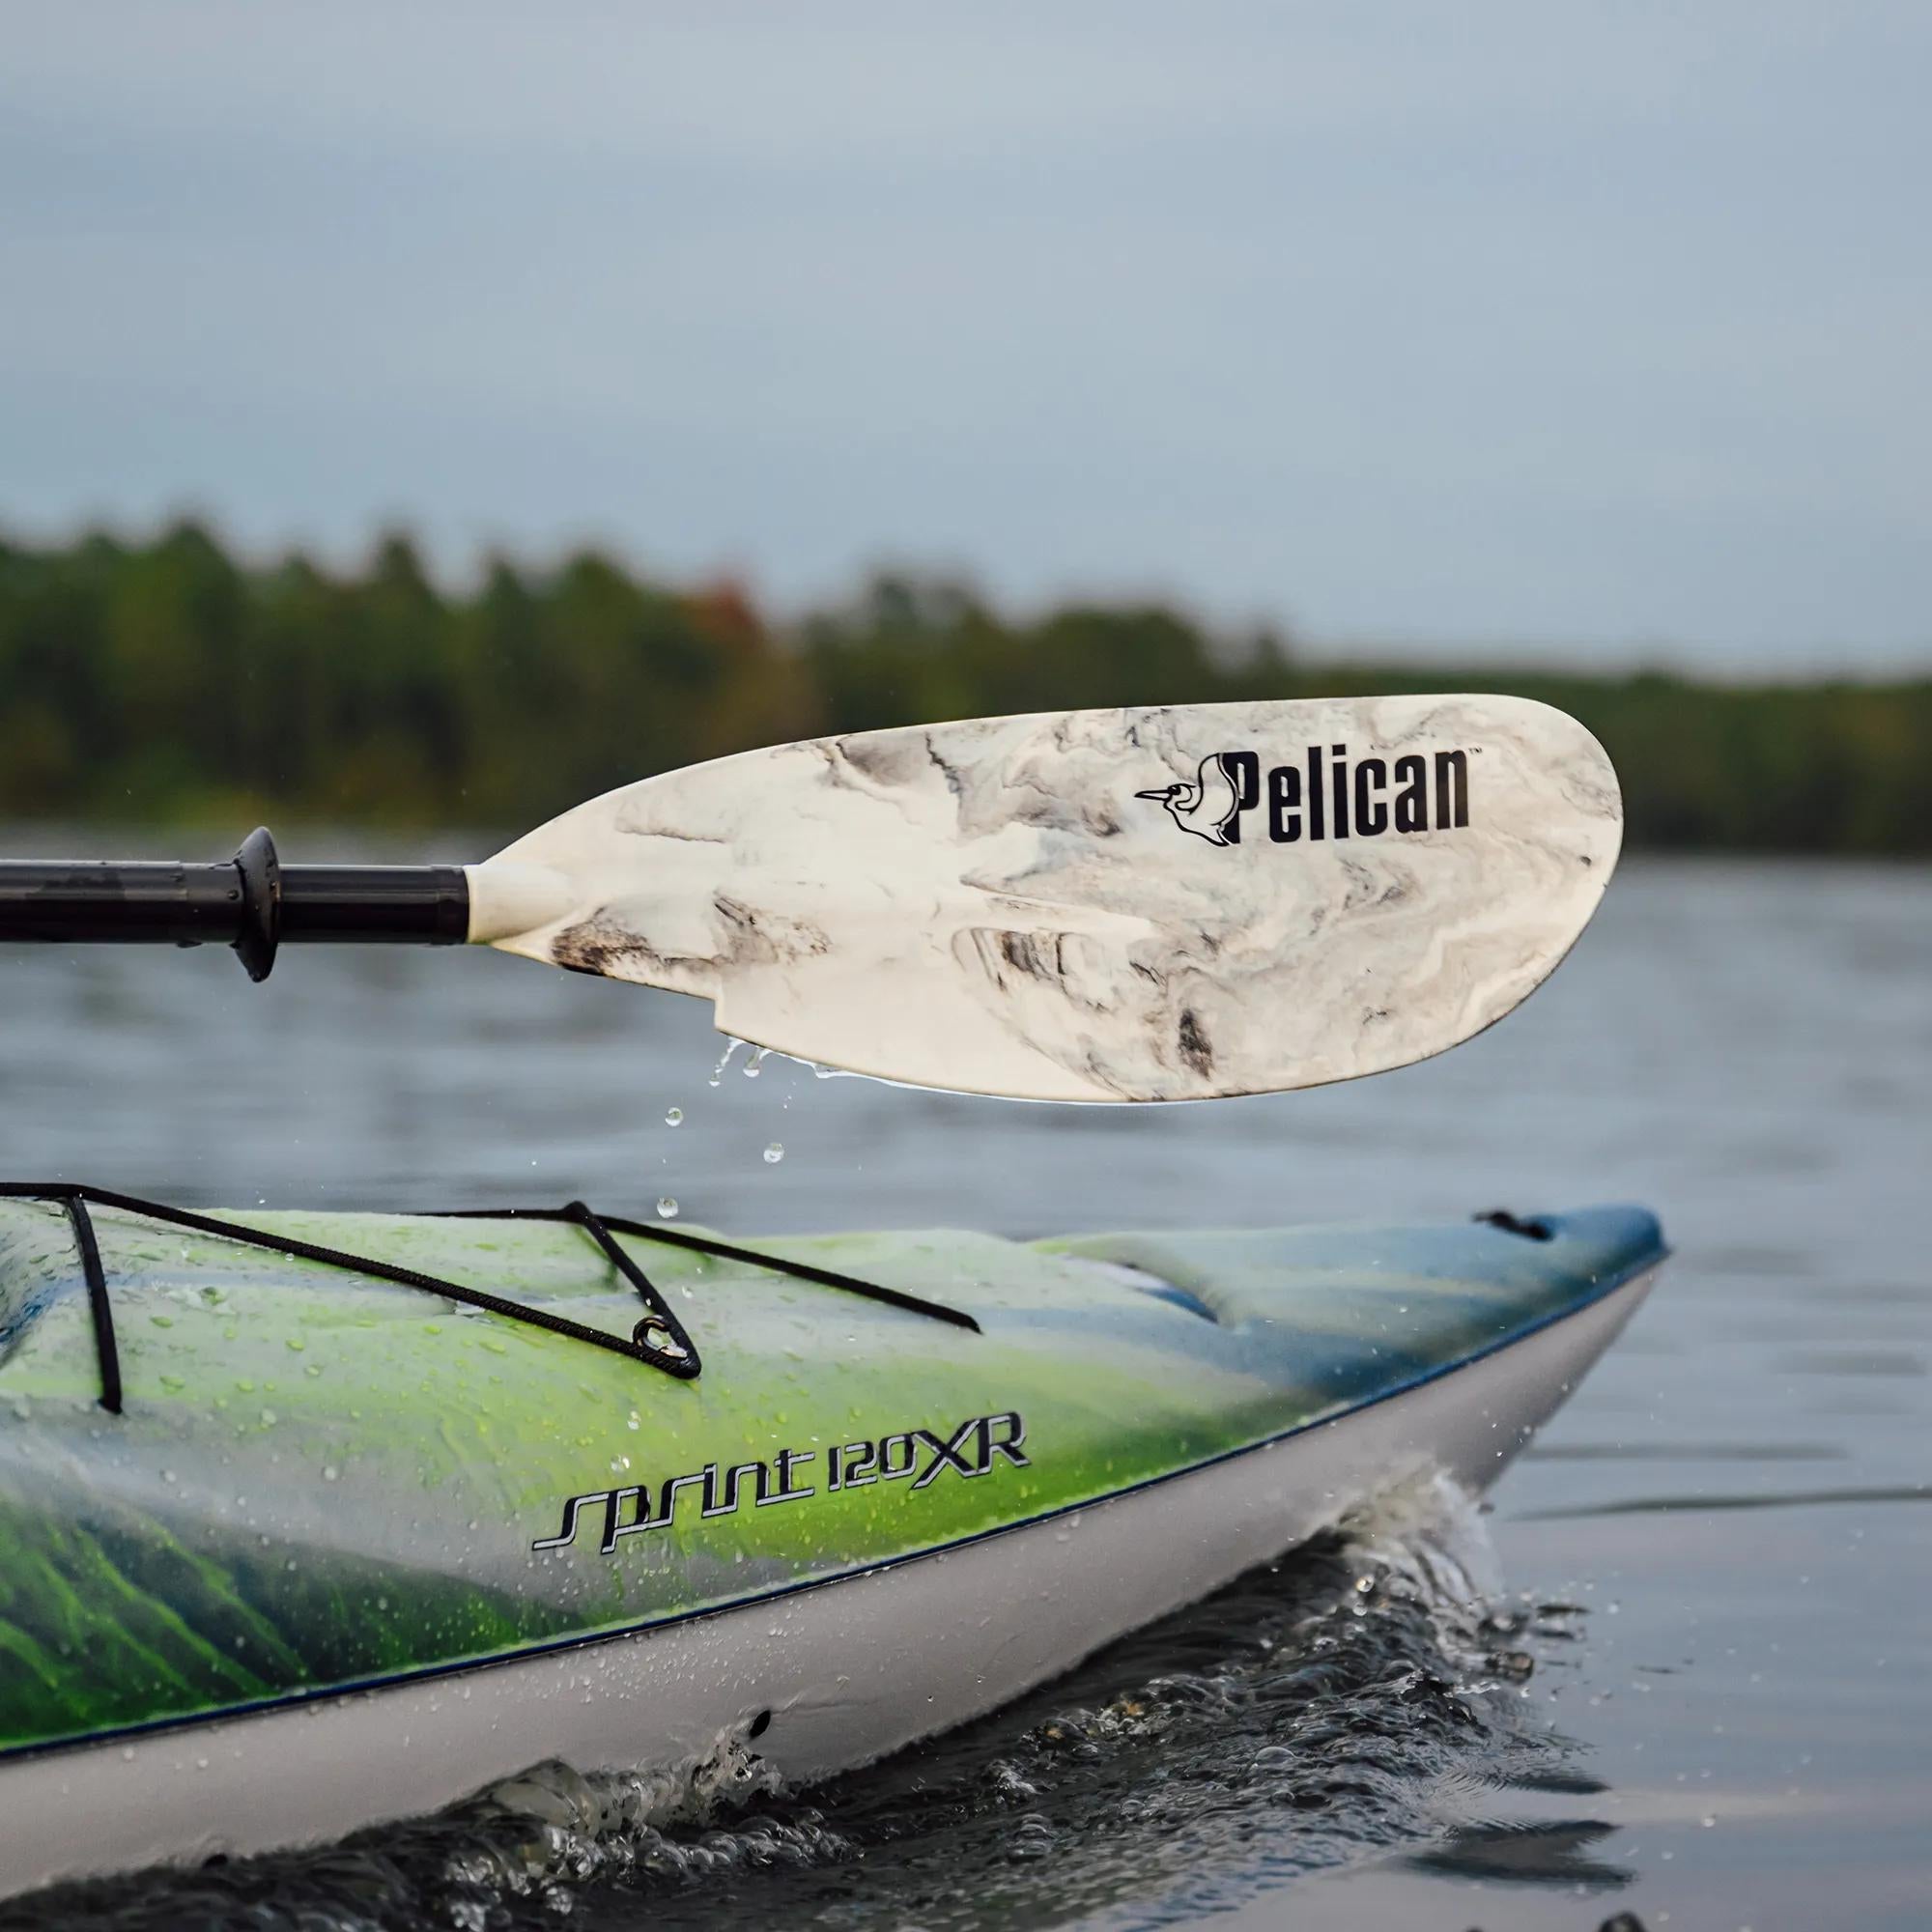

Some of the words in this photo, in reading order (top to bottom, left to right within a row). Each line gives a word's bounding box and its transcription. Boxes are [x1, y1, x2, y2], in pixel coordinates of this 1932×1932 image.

[1219, 744, 1469, 845] Pelican
[532, 1449, 816, 1553] sprint
[829, 1410, 1031, 1492] 120XR
